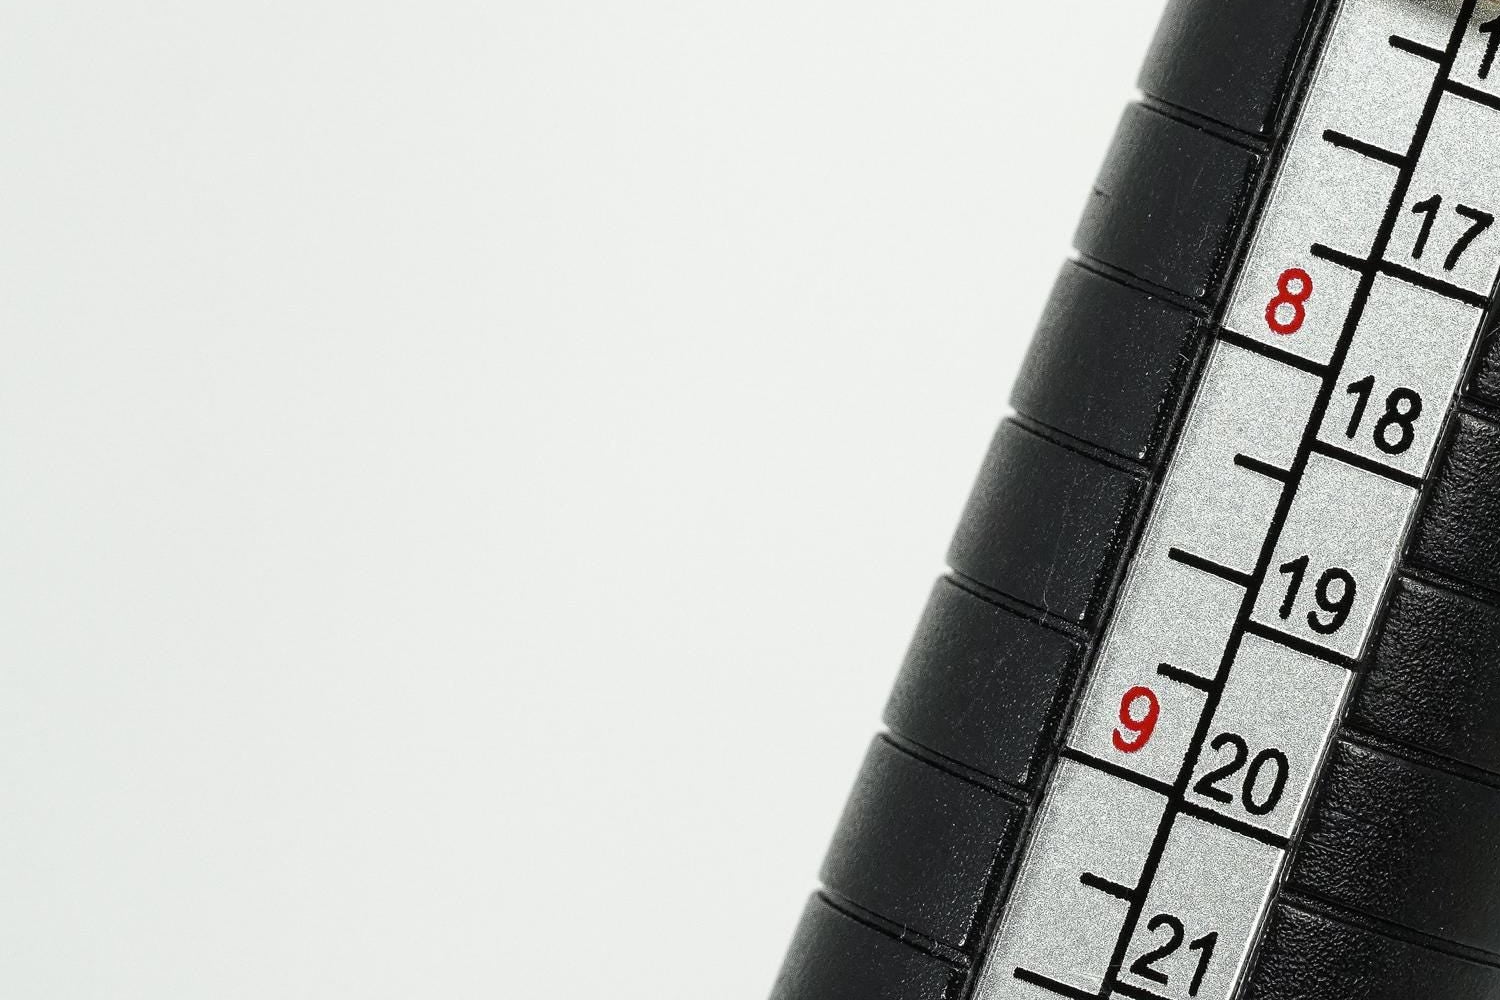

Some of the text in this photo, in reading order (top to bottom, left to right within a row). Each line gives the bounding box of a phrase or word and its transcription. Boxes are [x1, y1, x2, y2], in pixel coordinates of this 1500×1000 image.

[1411, 193, 1495, 271] 17
[1264, 267, 1313, 336] 8
[1344, 374, 1423, 456] 18
[1278, 554, 1357, 635] 19
[1112, 685, 1160, 754] 9
[1192, 732, 1290, 816] 20
[1129, 913, 1219, 998] 21
